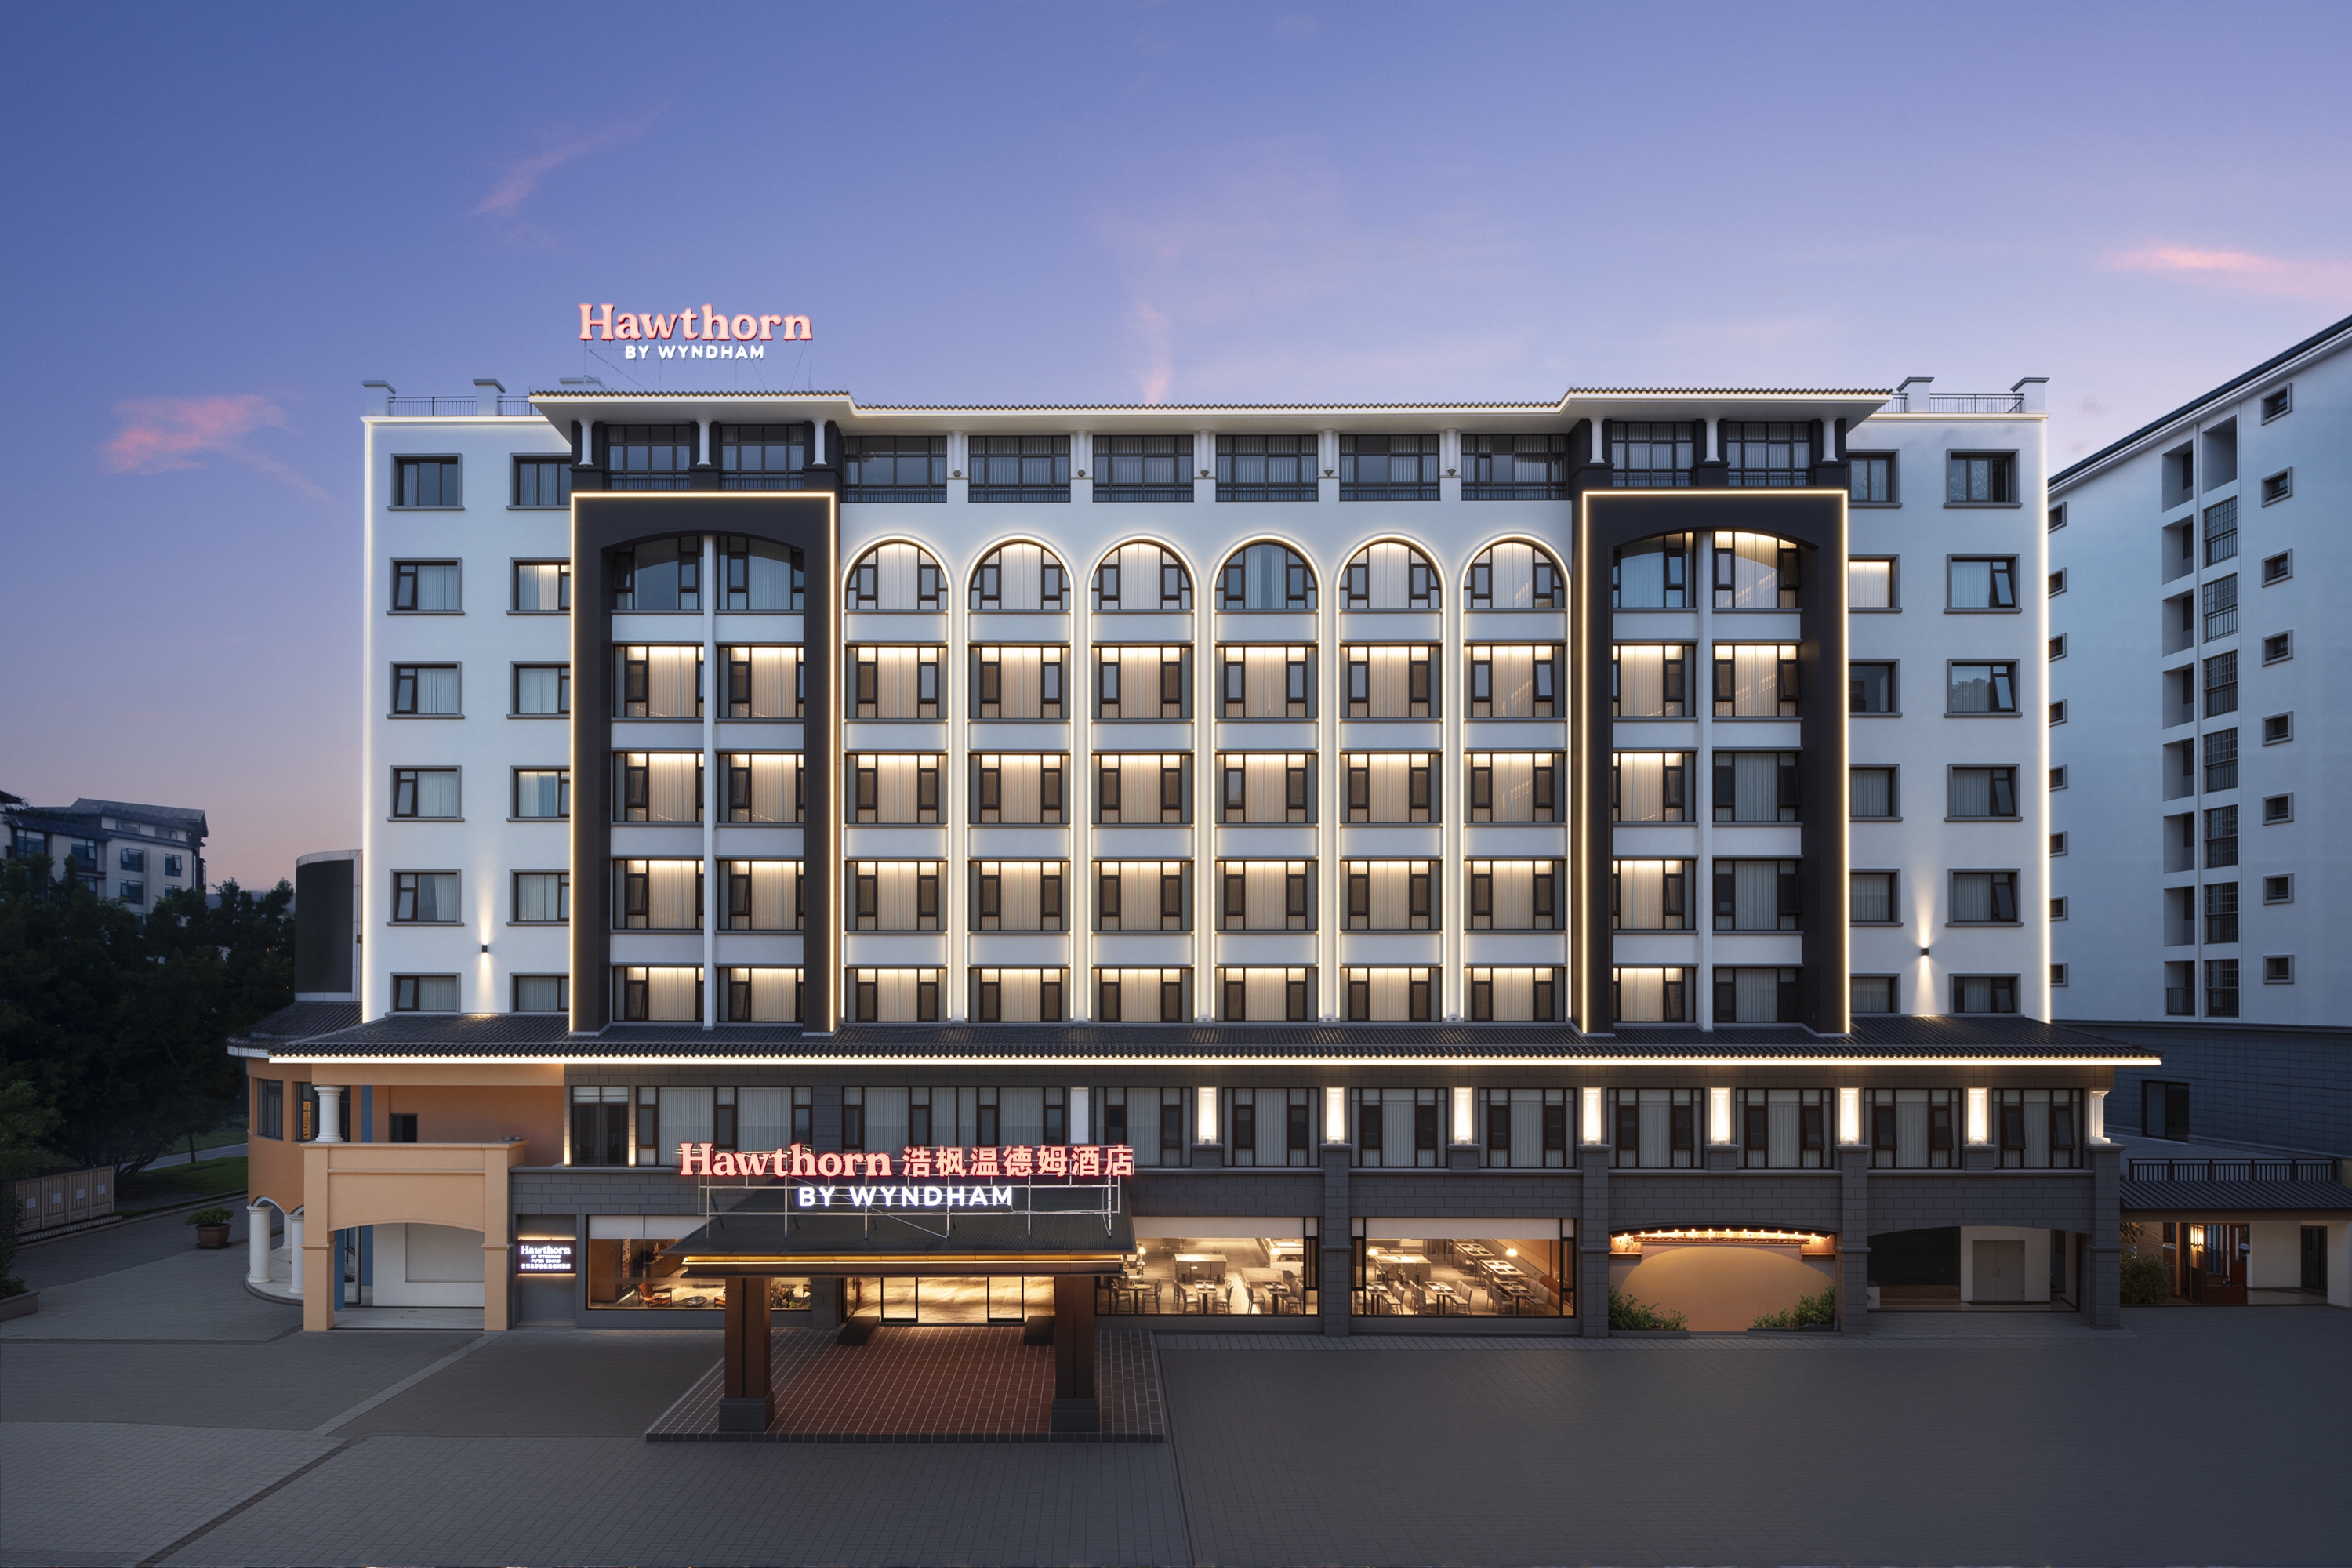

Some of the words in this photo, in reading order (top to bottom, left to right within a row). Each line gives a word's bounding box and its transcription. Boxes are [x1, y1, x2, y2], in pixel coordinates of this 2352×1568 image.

[579, 303, 812, 341] Hawthorn
[625, 344, 649, 359] BY
[658, 344, 764, 359] WYNDHAM
[680, 1142, 893, 1177] Hawthorn
[902, 1144, 1134, 1177] 浩枫温德姆酒店
[798, 1185, 835, 1207] BY
[849, 1185, 1013, 1207] WYNDHAM
[521, 1245, 571, 1254] Hawthorn
